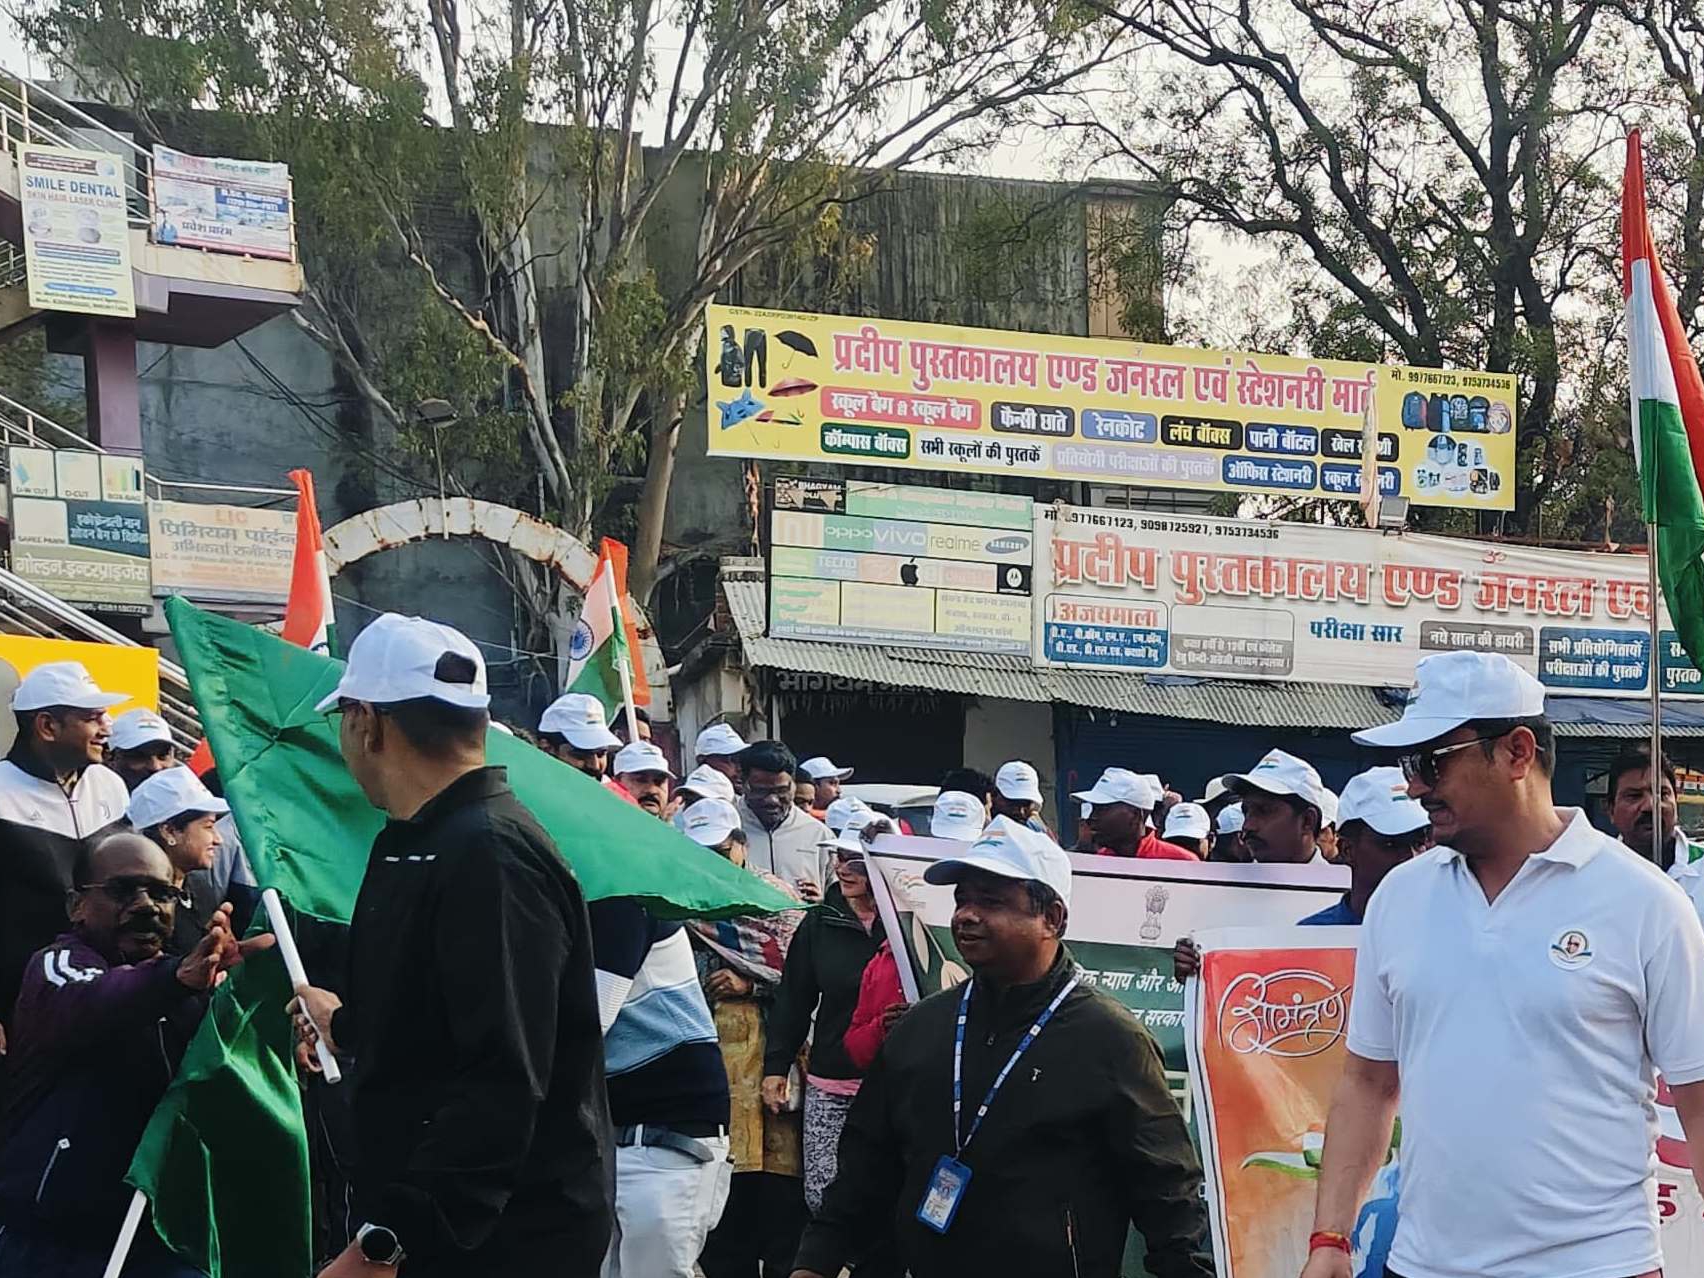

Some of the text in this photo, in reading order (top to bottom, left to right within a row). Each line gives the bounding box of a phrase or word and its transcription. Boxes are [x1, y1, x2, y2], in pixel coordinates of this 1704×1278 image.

[26, 175, 122, 198] SMILE DENTAL
[832, 325, 902, 375] प्रदीप
[909, 340, 1039, 390] पुस्तकालय
[1046, 353, 1100, 392] एण्ड
[1105, 359, 1187, 400] जनरल
[1193, 357, 1230, 403] एवं
[1236, 359, 1326, 411] स्टेशनरी
[831, 391, 868, 418] स्कूल
[871, 393, 894, 415] बैग
[911, 398, 946, 424] स्कूल
[950, 398, 973, 422] बैग
[1000, 407, 1068, 433] फैन्सी छाते
[1095, 412, 1147, 439] रेनकोट
[1169, 421, 1231, 445] लंच बॉक्स
[824, 428, 907, 453] कॉम्पास बॉक्स
[920, 436, 1041, 466] सभी स्कूलों की पुस्तकें
[1249, 427, 1317, 452] पानी बॉटल
[1331, 433, 1355, 452] खेल
[1057, 447, 1106, 469] प्रतियोगी
[1162, 454, 1178, 474] की
[1181, 457, 1215, 480] पुस्तकें
[1229, 462, 1313, 485] ऑफिस स्टेशनरी
[1324, 469, 1353, 491] स्कूल
[1066, 510, 1138, 531] 977667123,
[874, 526, 927, 546] vivo
[930, 533, 982, 552] realme
[818, 556, 856, 568] TECNO
[1051, 531, 1161, 588] प्रदीप
[1169, 549, 1373, 606] पुस्तकालय
[1382, 563, 1465, 609] एण्ड
[1474, 571, 1597, 617] जनरल
[1310, 616, 1405, 643] परीक्षा सार
[1430, 629, 1525, 650] नये साल की डायरी
[1549, 638, 1571, 655] सभी
[1545, 658, 1645, 683] परीक्षाओं की पुस्तकें
[1102, 970, 1136, 991] न्याय
[1136, 968, 1166, 993] और
